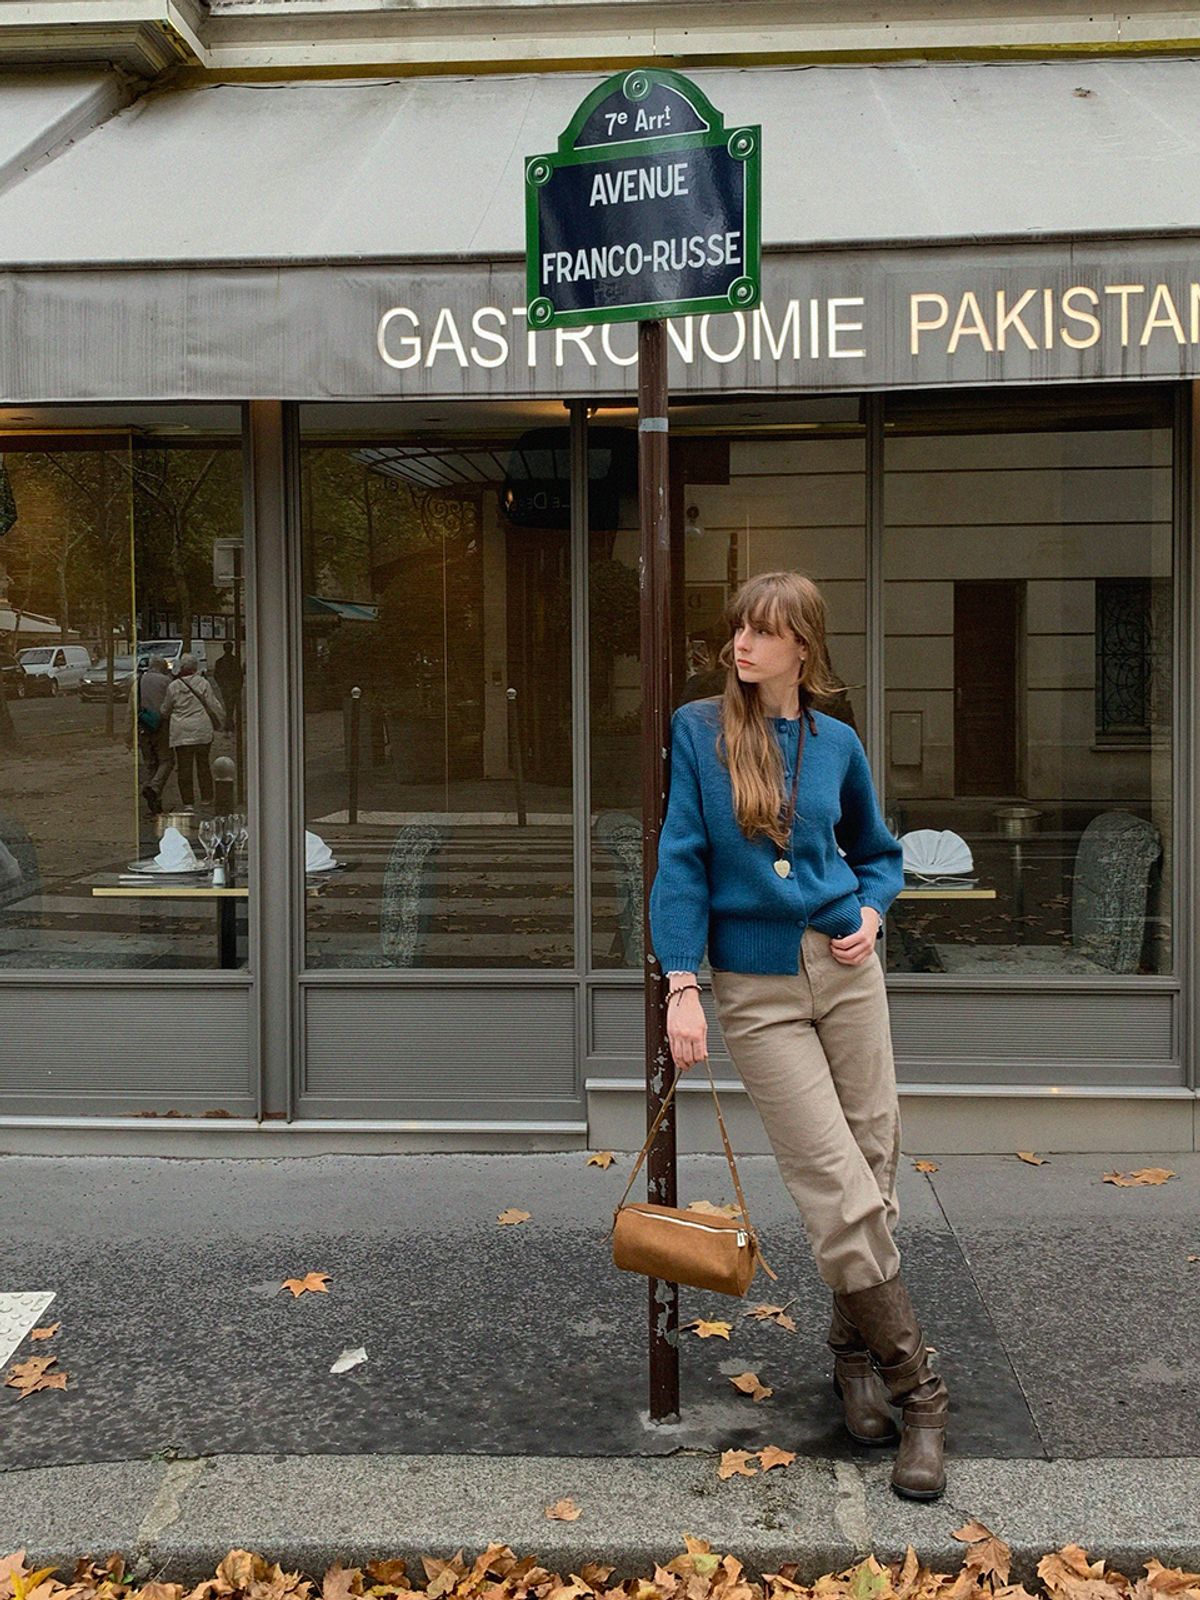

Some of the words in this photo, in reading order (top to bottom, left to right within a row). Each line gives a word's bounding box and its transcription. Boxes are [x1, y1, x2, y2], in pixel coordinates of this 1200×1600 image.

[604, 111, 628, 136] 7e
[589, 162, 689, 207] AVENUE
[542, 230, 741, 285] FRANCO-RUSSE
[910, 283, 1200, 355] PAKISTA
